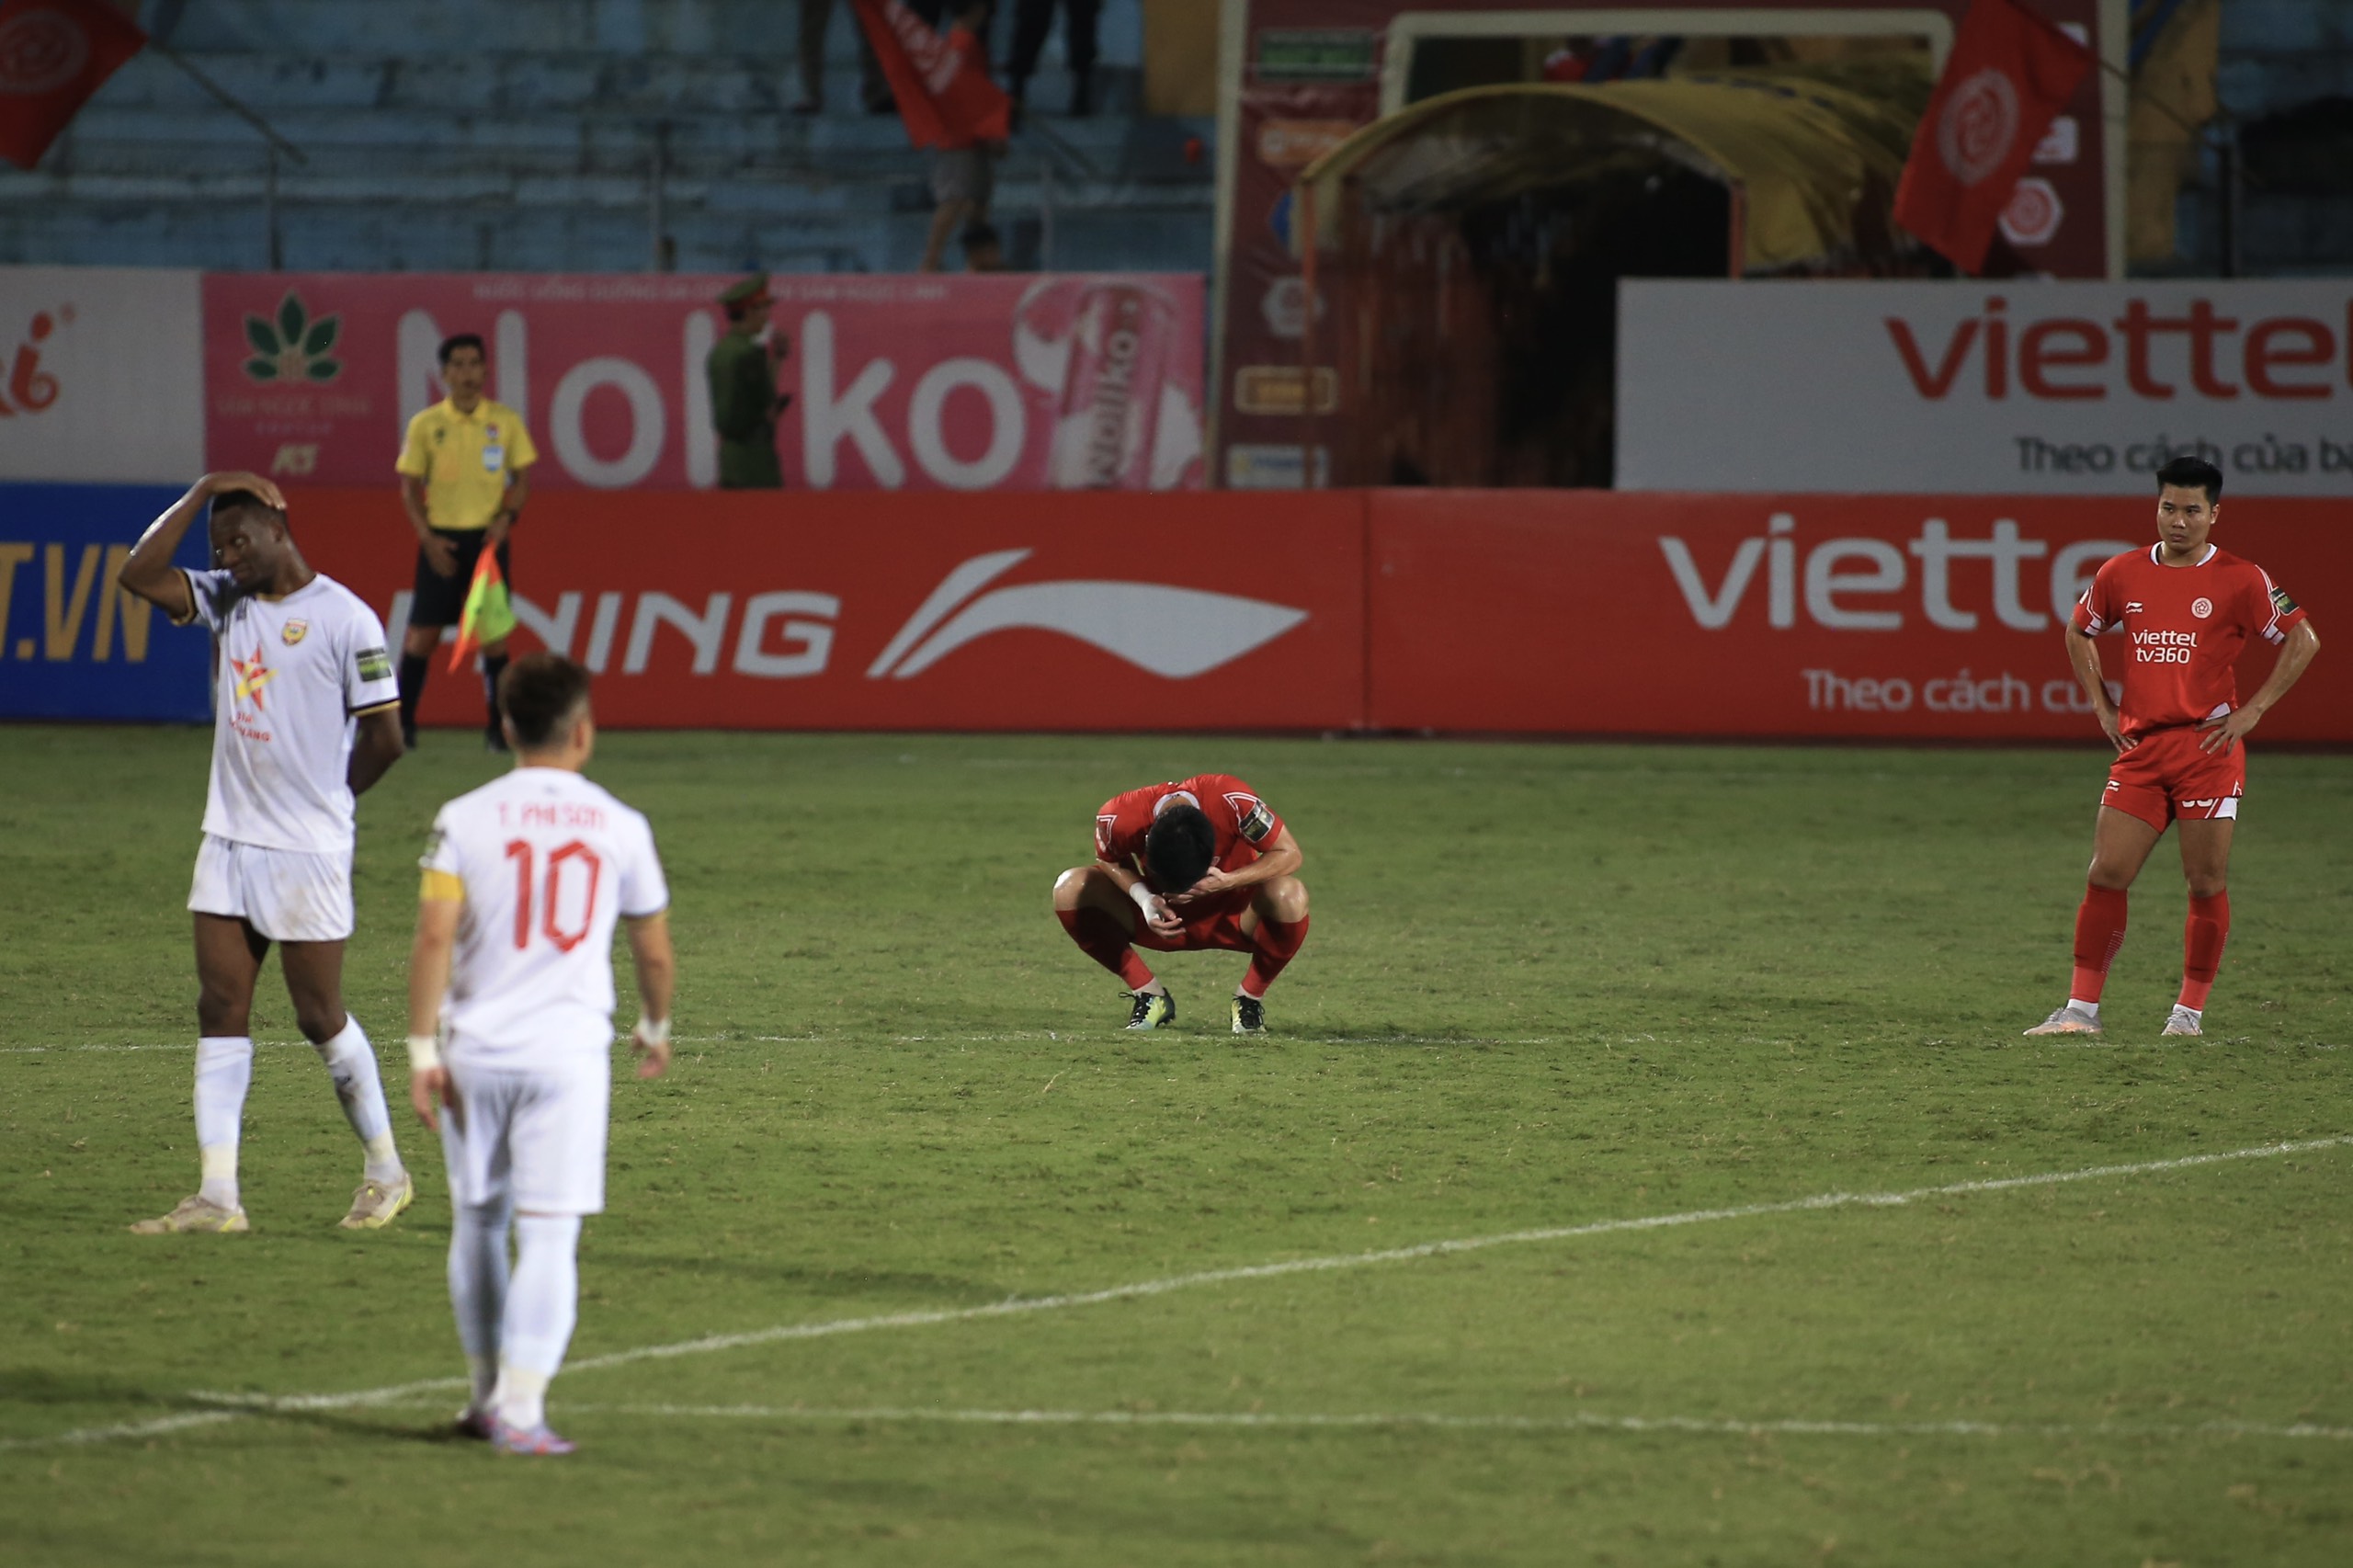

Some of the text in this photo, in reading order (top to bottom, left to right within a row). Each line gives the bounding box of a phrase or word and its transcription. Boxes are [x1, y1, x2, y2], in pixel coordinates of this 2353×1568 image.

[397, 309, 1028, 490] Nolko
[2014, 436, 2115, 474] Theo
[2233, 433, 2309, 472] của
[1657, 513, 2142, 631] viette
[2132, 629, 2198, 647] viettel
[2136, 647, 2190, 664] tv360
[1802, 668, 1913, 711] Theo
[1924, 668, 2030, 711] cách
[504, 838, 602, 953] 10
